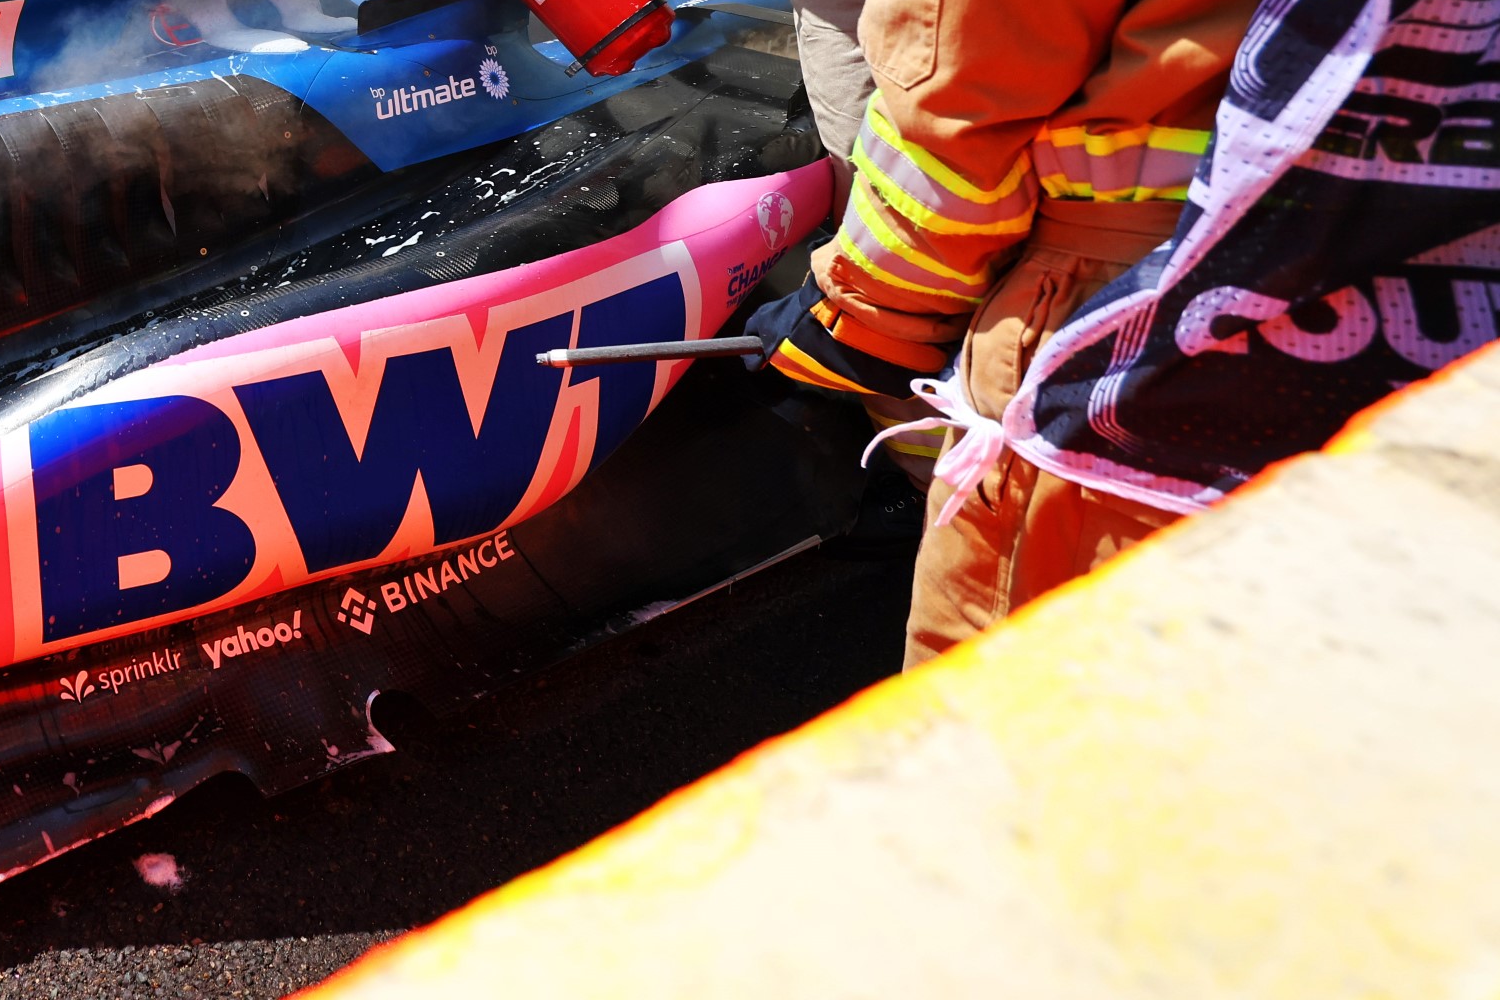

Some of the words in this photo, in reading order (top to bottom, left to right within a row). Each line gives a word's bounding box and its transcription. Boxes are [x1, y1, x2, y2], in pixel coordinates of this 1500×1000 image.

[485, 44, 498, 57] bp
[370, 86, 386, 100] bp
[376, 75, 477, 120] ultimate
[30, 271, 687, 644] BWT
[380, 530, 515, 613] BINANCE
[201, 611, 302, 669] yahoo!
[98, 648, 182, 695] sprinklr
